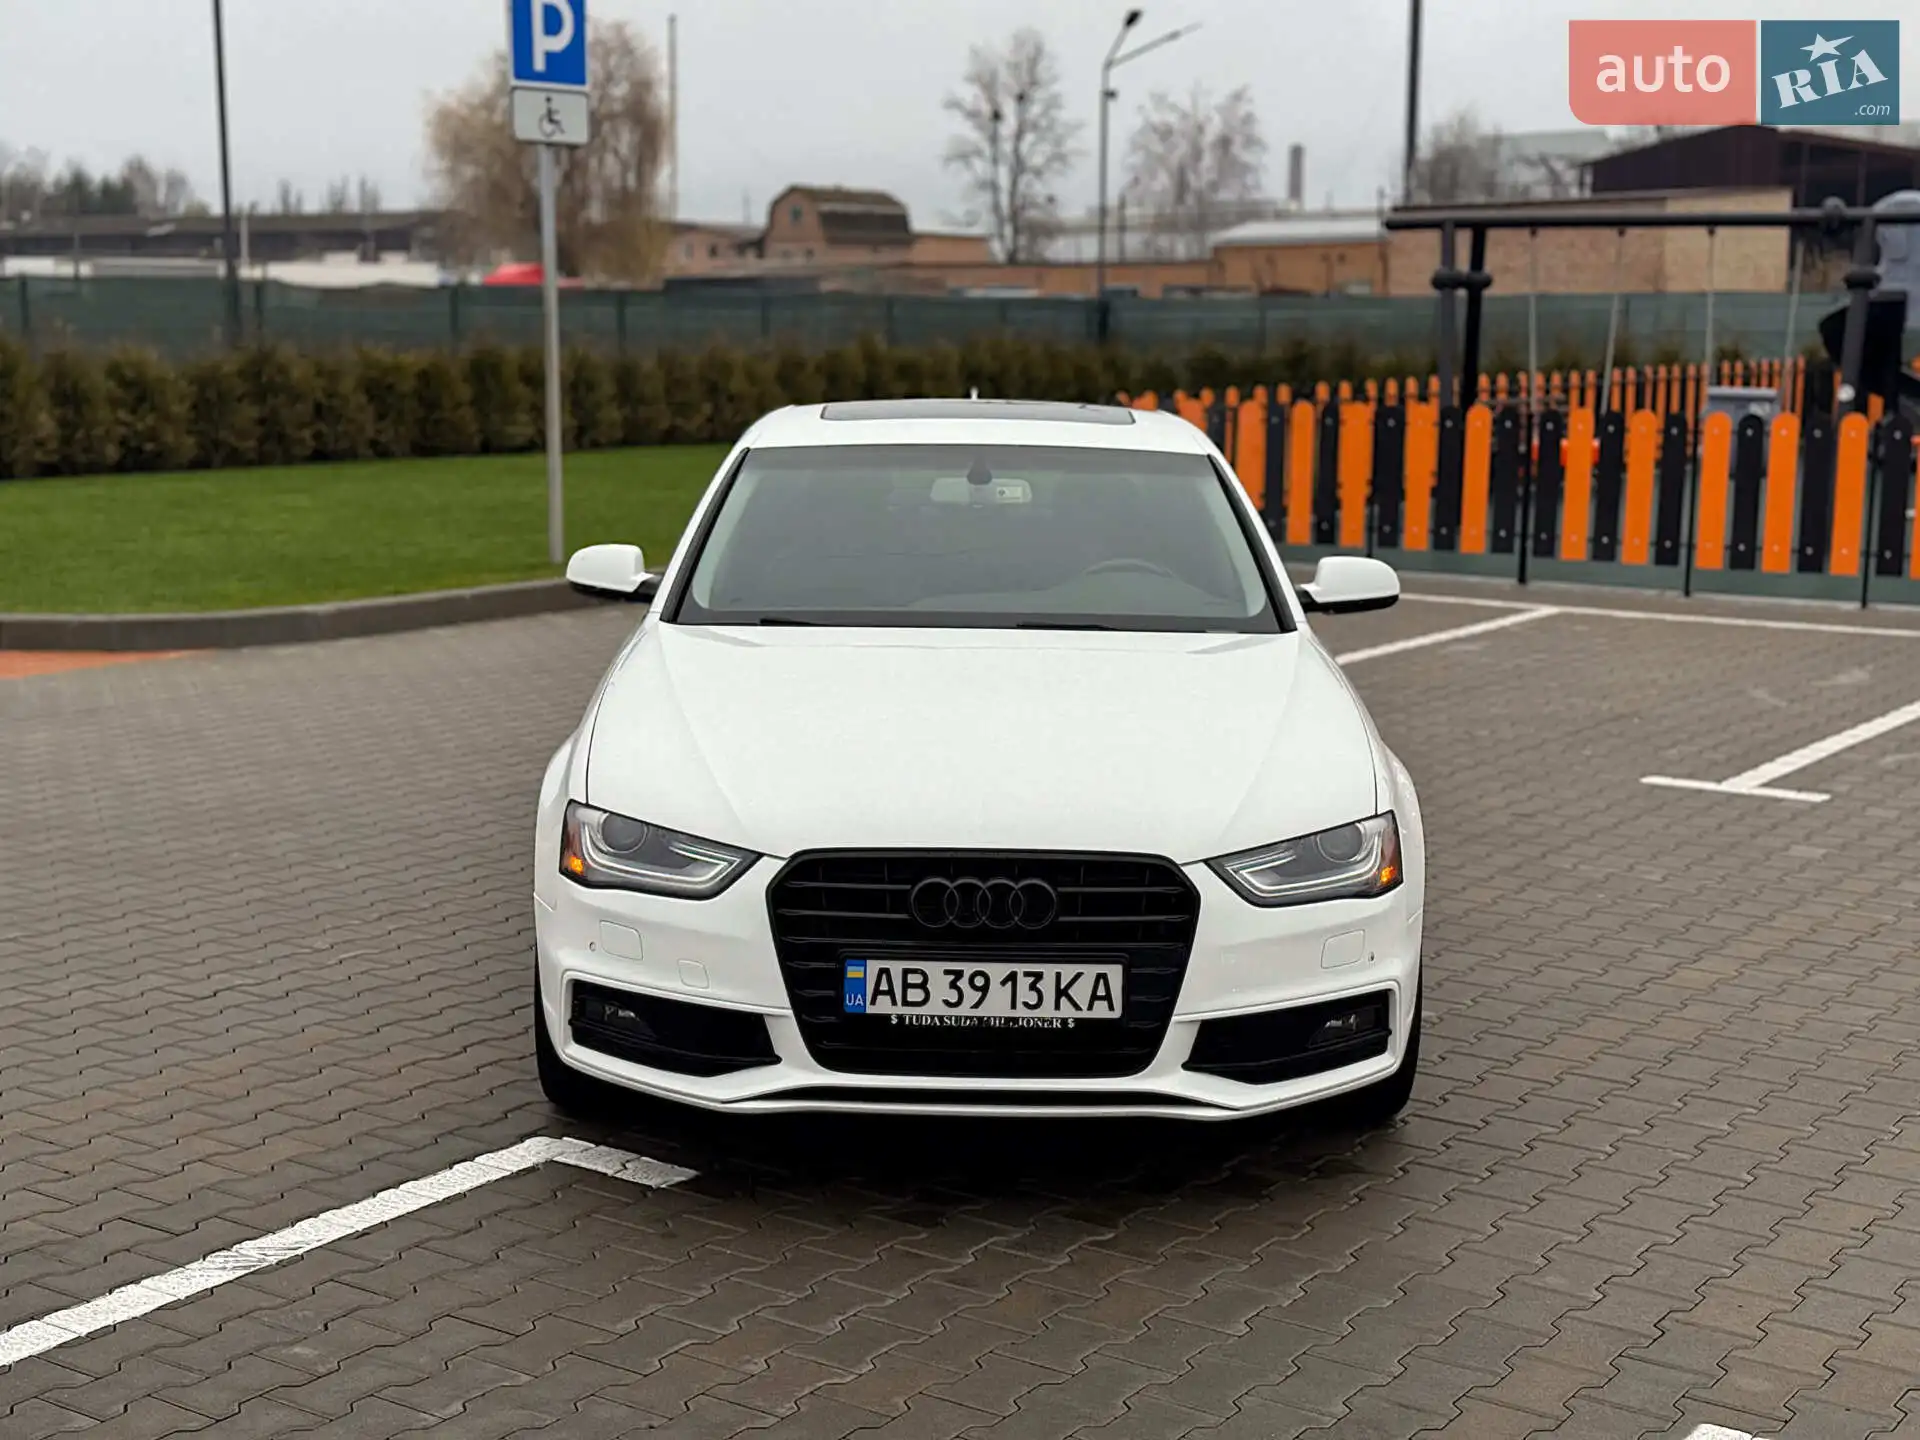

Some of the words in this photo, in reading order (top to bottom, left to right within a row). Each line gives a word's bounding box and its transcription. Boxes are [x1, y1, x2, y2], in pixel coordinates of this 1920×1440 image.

[532, 0, 574, 72] P
[846, 993, 864, 1007] UA
[869, 967, 931, 1008] AB
[942, 967, 1044, 1011] 3913
[1054, 971, 1115, 1012] KA
[904, 1014, 940, 1026] TUDA
[943, 1015, 979, 1027] SUDA
